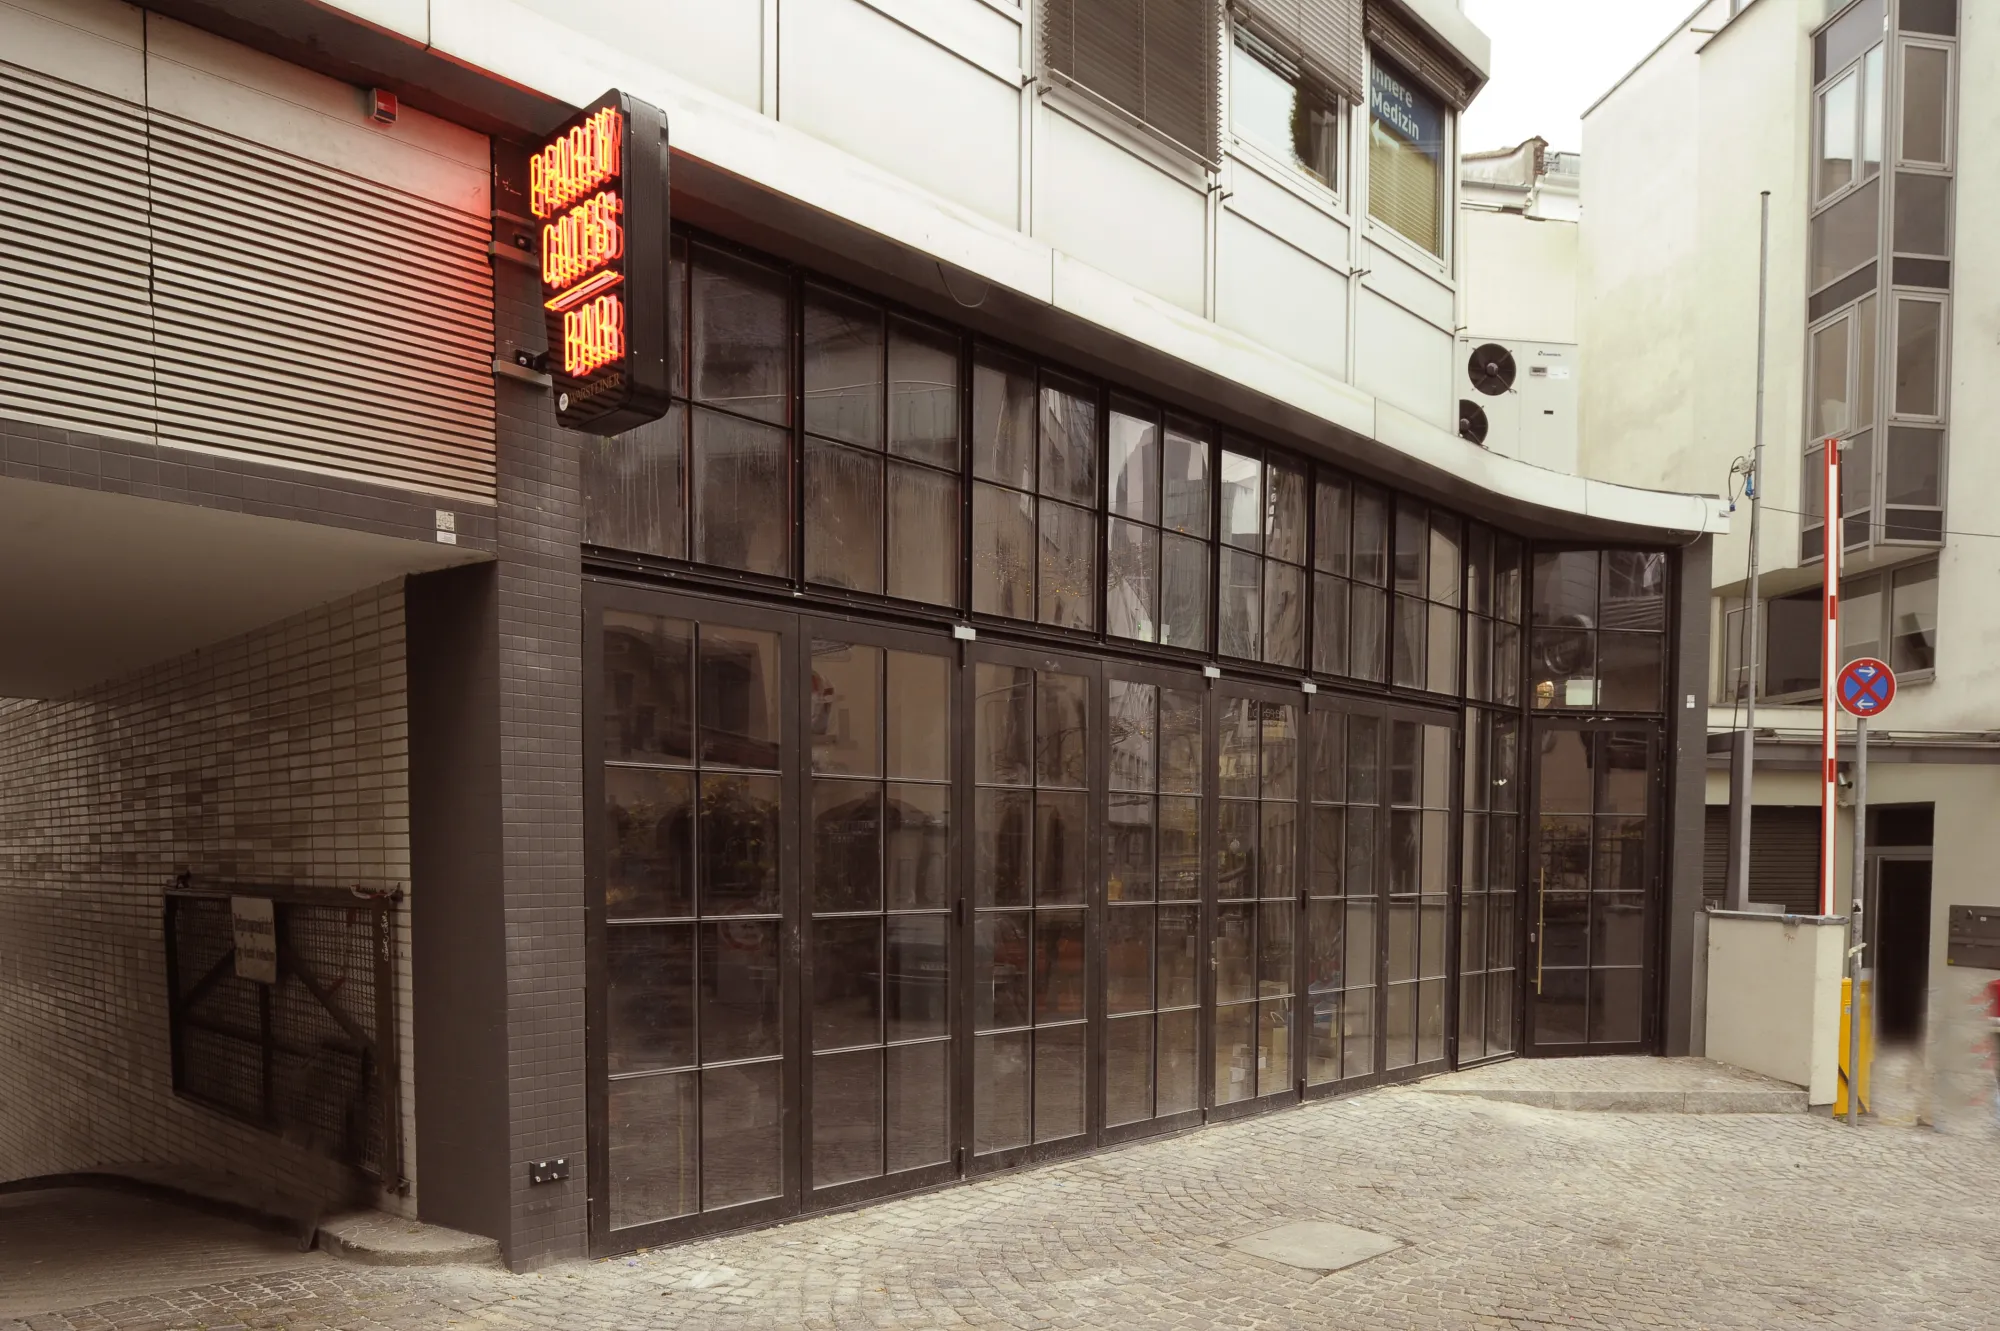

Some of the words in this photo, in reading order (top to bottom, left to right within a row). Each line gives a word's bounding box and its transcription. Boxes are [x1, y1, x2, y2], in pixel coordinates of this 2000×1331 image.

[1371, 60, 1413, 108] Innere
[1371, 86, 1419, 141] Medizin
[531, 105, 620, 219] PEARLY
[543, 190, 621, 289] GATES
[564, 295, 622, 378] BAR
[569, 372, 620, 405] WARSTEINER
